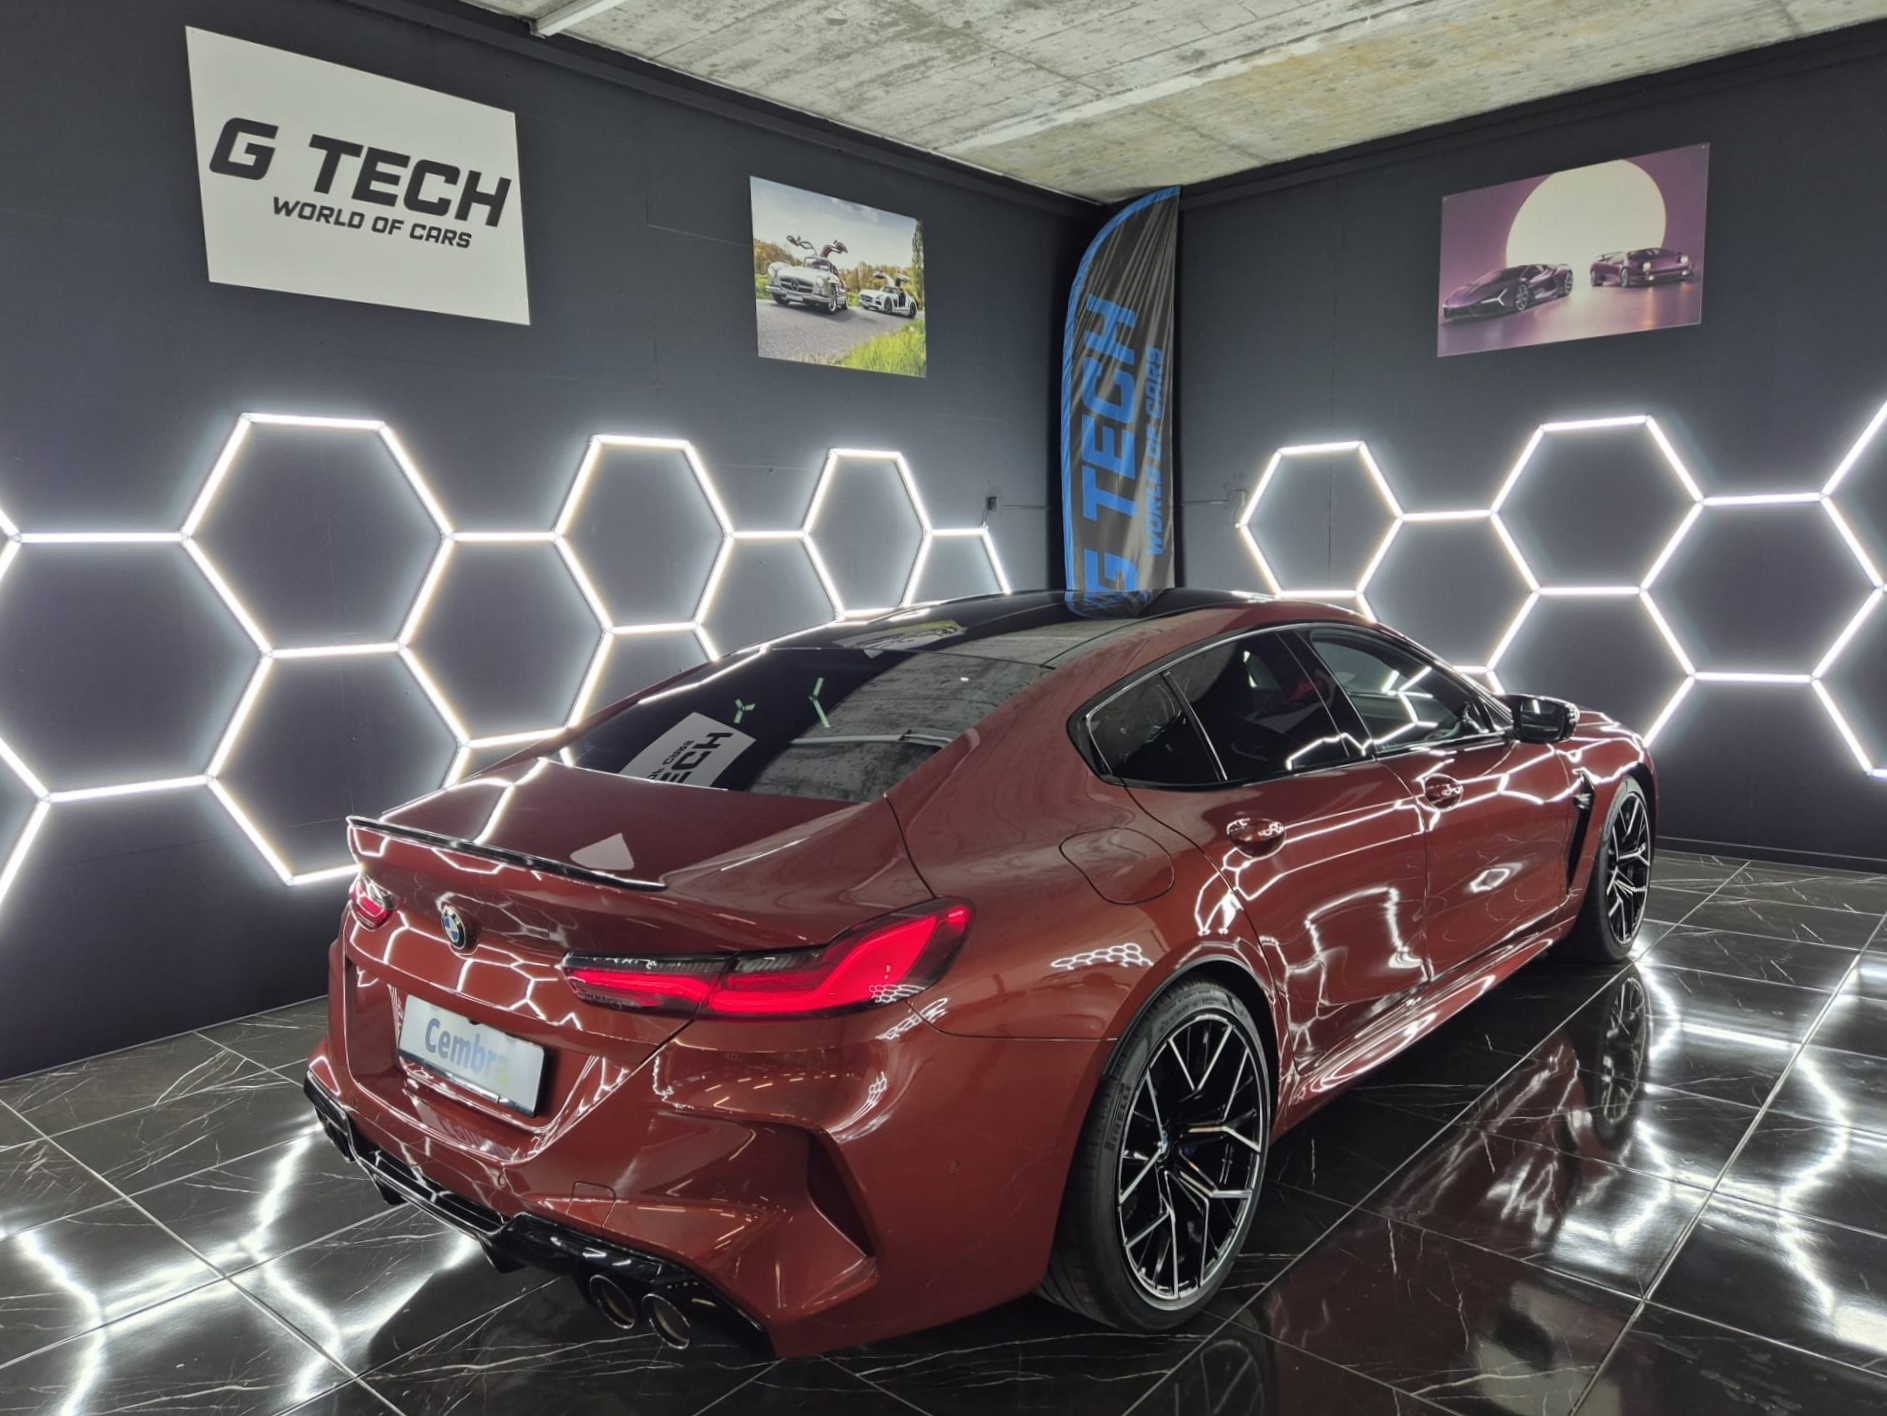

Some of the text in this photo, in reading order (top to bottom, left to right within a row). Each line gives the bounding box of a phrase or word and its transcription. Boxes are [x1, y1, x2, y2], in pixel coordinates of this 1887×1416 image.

[209, 117, 512, 227] G TECH
[273, 196, 472, 249] WORLD OF CARS
[1081, 295, 1138, 520] TECH
[1144, 346, 1163, 556] WORLD OF CARS
[424, 1017, 510, 1088] Cembra
